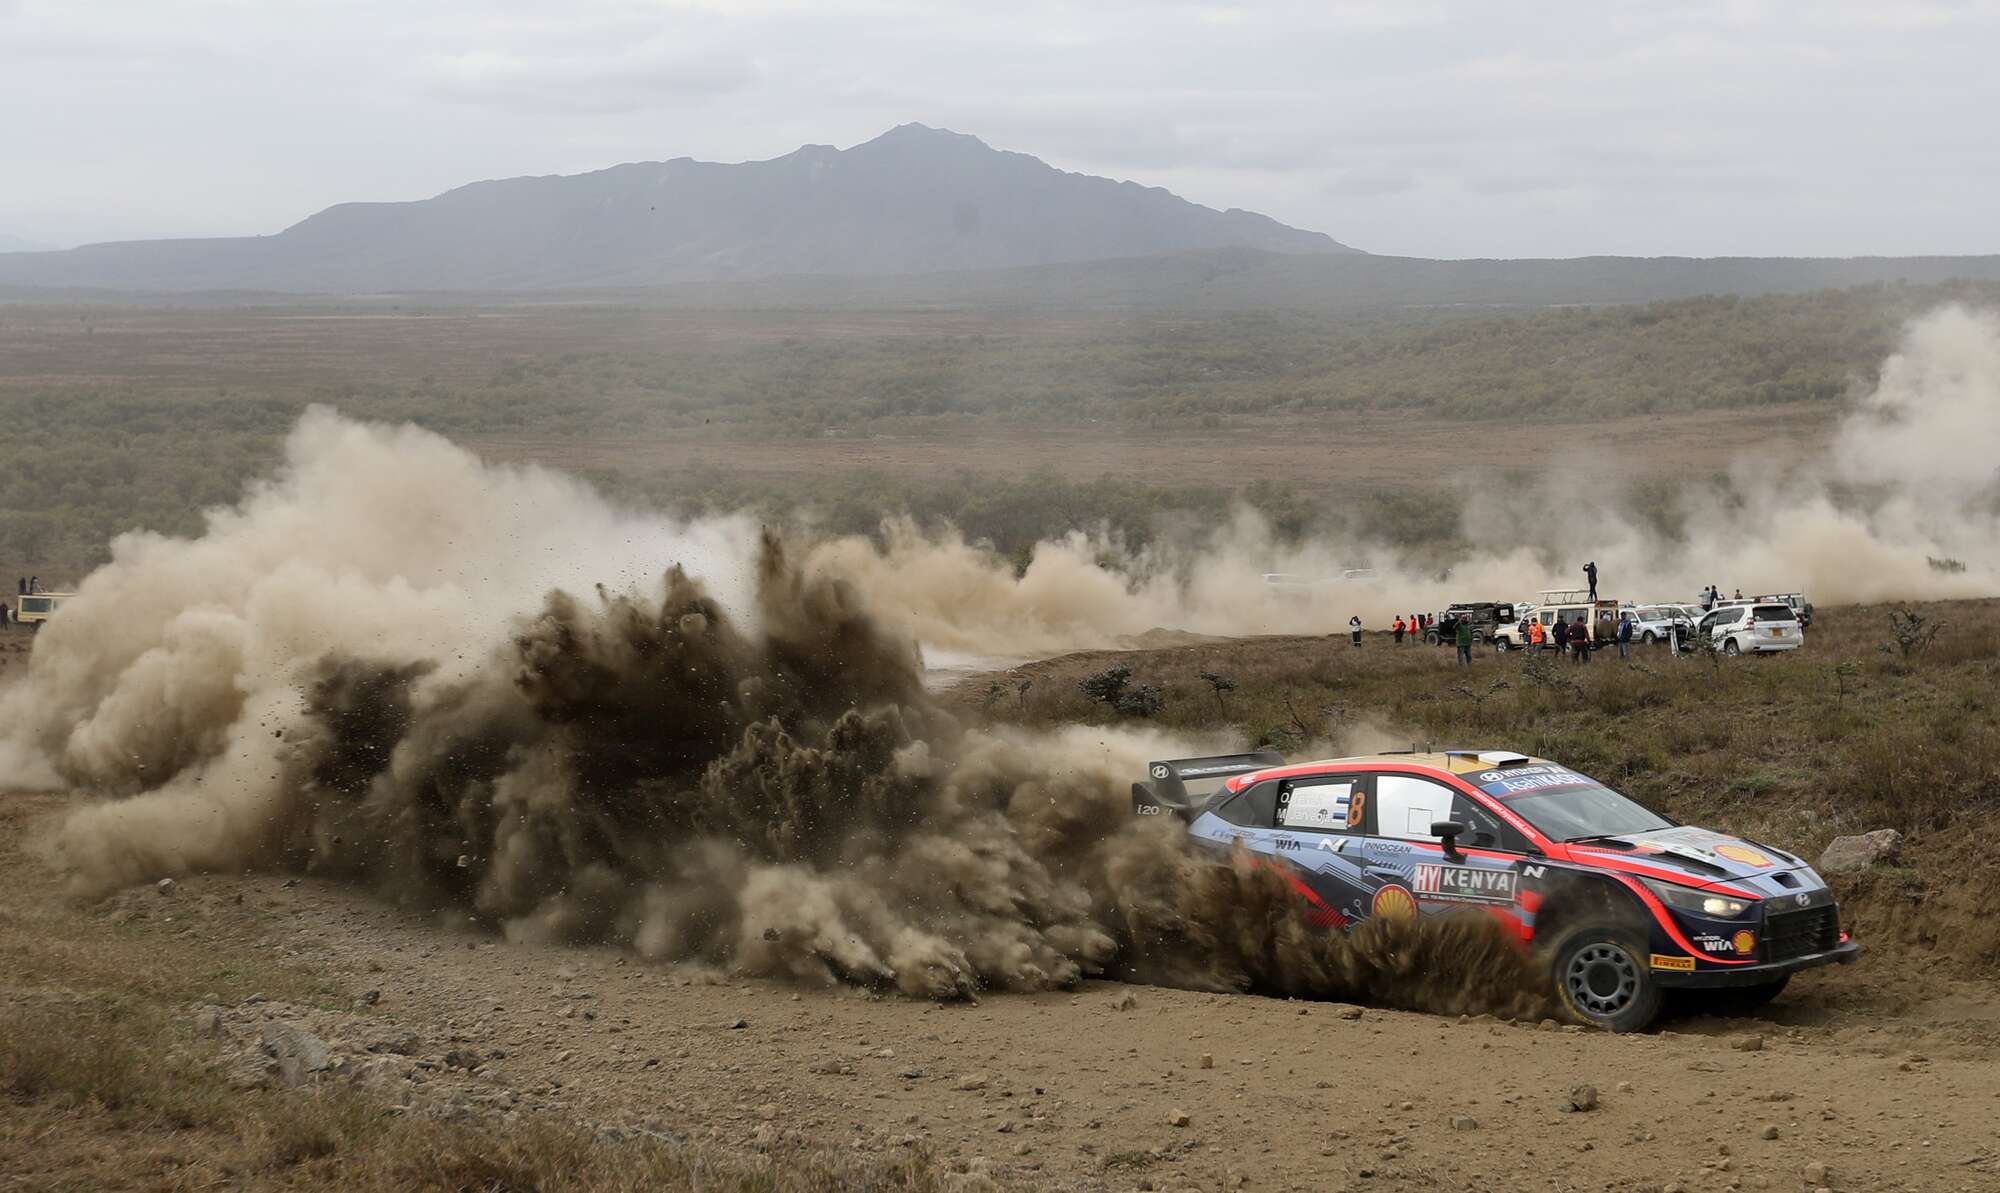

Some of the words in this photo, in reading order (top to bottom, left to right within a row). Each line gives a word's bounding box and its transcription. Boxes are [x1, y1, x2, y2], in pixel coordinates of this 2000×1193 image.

[1137, 803, 1160, 816] i20
[1349, 792, 1365, 825] 8
[1275, 838, 1301, 852] WIA
[1416, 865, 1440, 891] HY
[1442, 867, 1509, 892] KENYA
[1703, 939, 1734, 951] WIA
